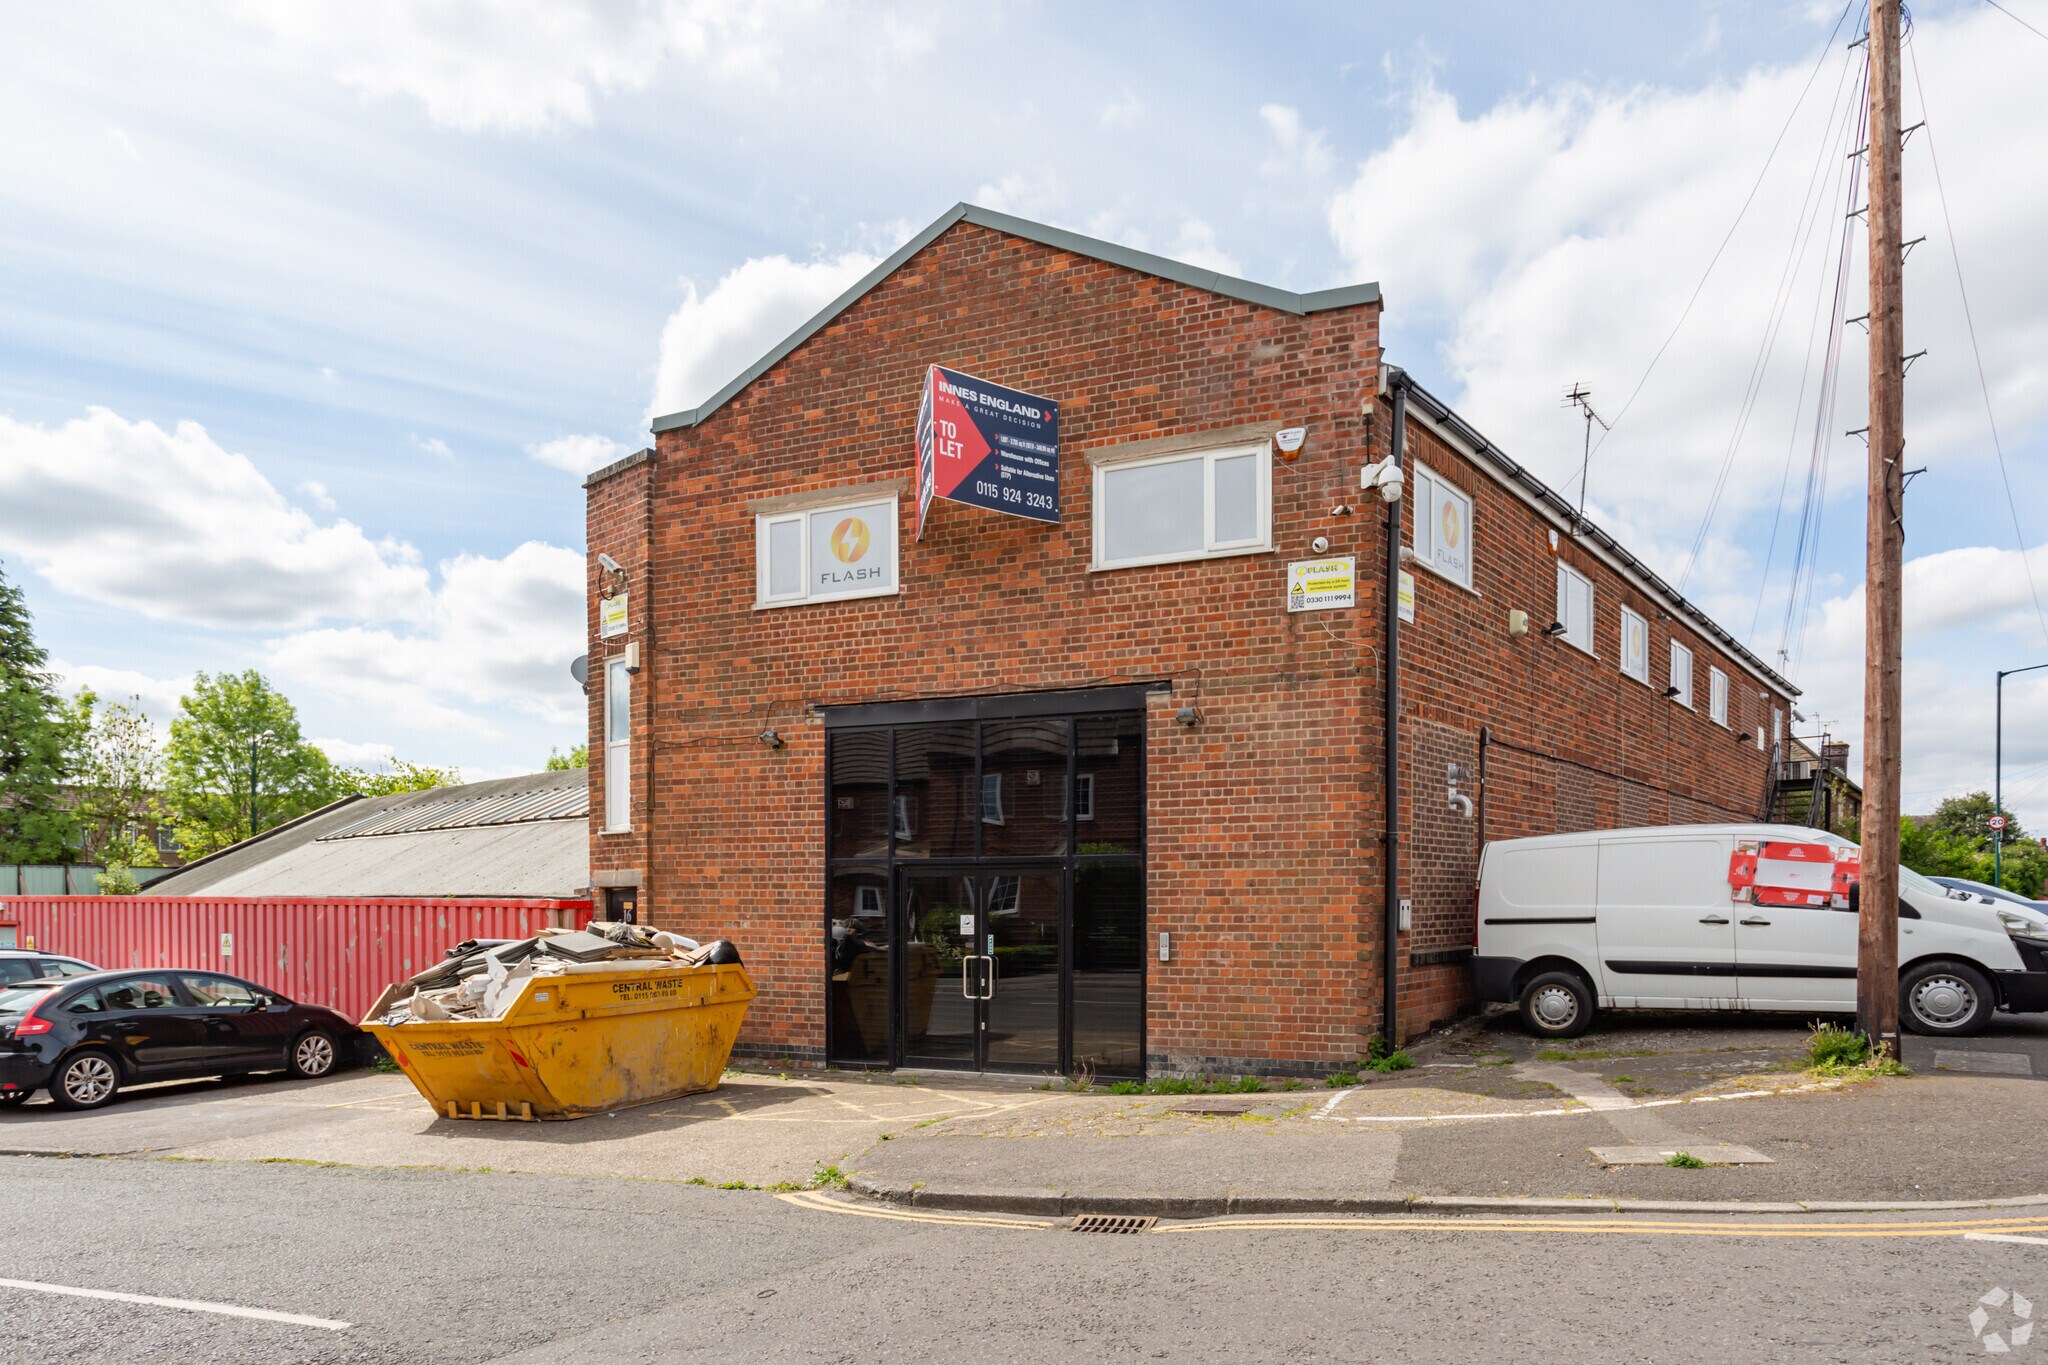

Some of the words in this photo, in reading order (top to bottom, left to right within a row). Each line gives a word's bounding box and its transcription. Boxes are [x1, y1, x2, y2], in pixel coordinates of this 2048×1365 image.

[938, 381, 978, 401] INNES
[979, 393, 1040, 419] ENGLAND
[938, 395, 961, 407] MAKE
[974, 406, 998, 418] GREAT
[1003, 414, 1042, 429] DECISION
[940, 420, 956, 438] TO
[939, 438, 963, 459] LET
[976, 480, 998, 498] 0115
[1003, 487, 1021, 504] 924
[1026, 493, 1053, 510] 3243
[1307, 565, 1338, 573] FLASH
[1438, 549, 1465, 573] FLASH
[822, 567, 881, 584] FLASH
[613, 982, 652, 993] CENTRAL
[655, 979, 682, 989] WASTE
[452, 1041, 484, 1049] WASTE
